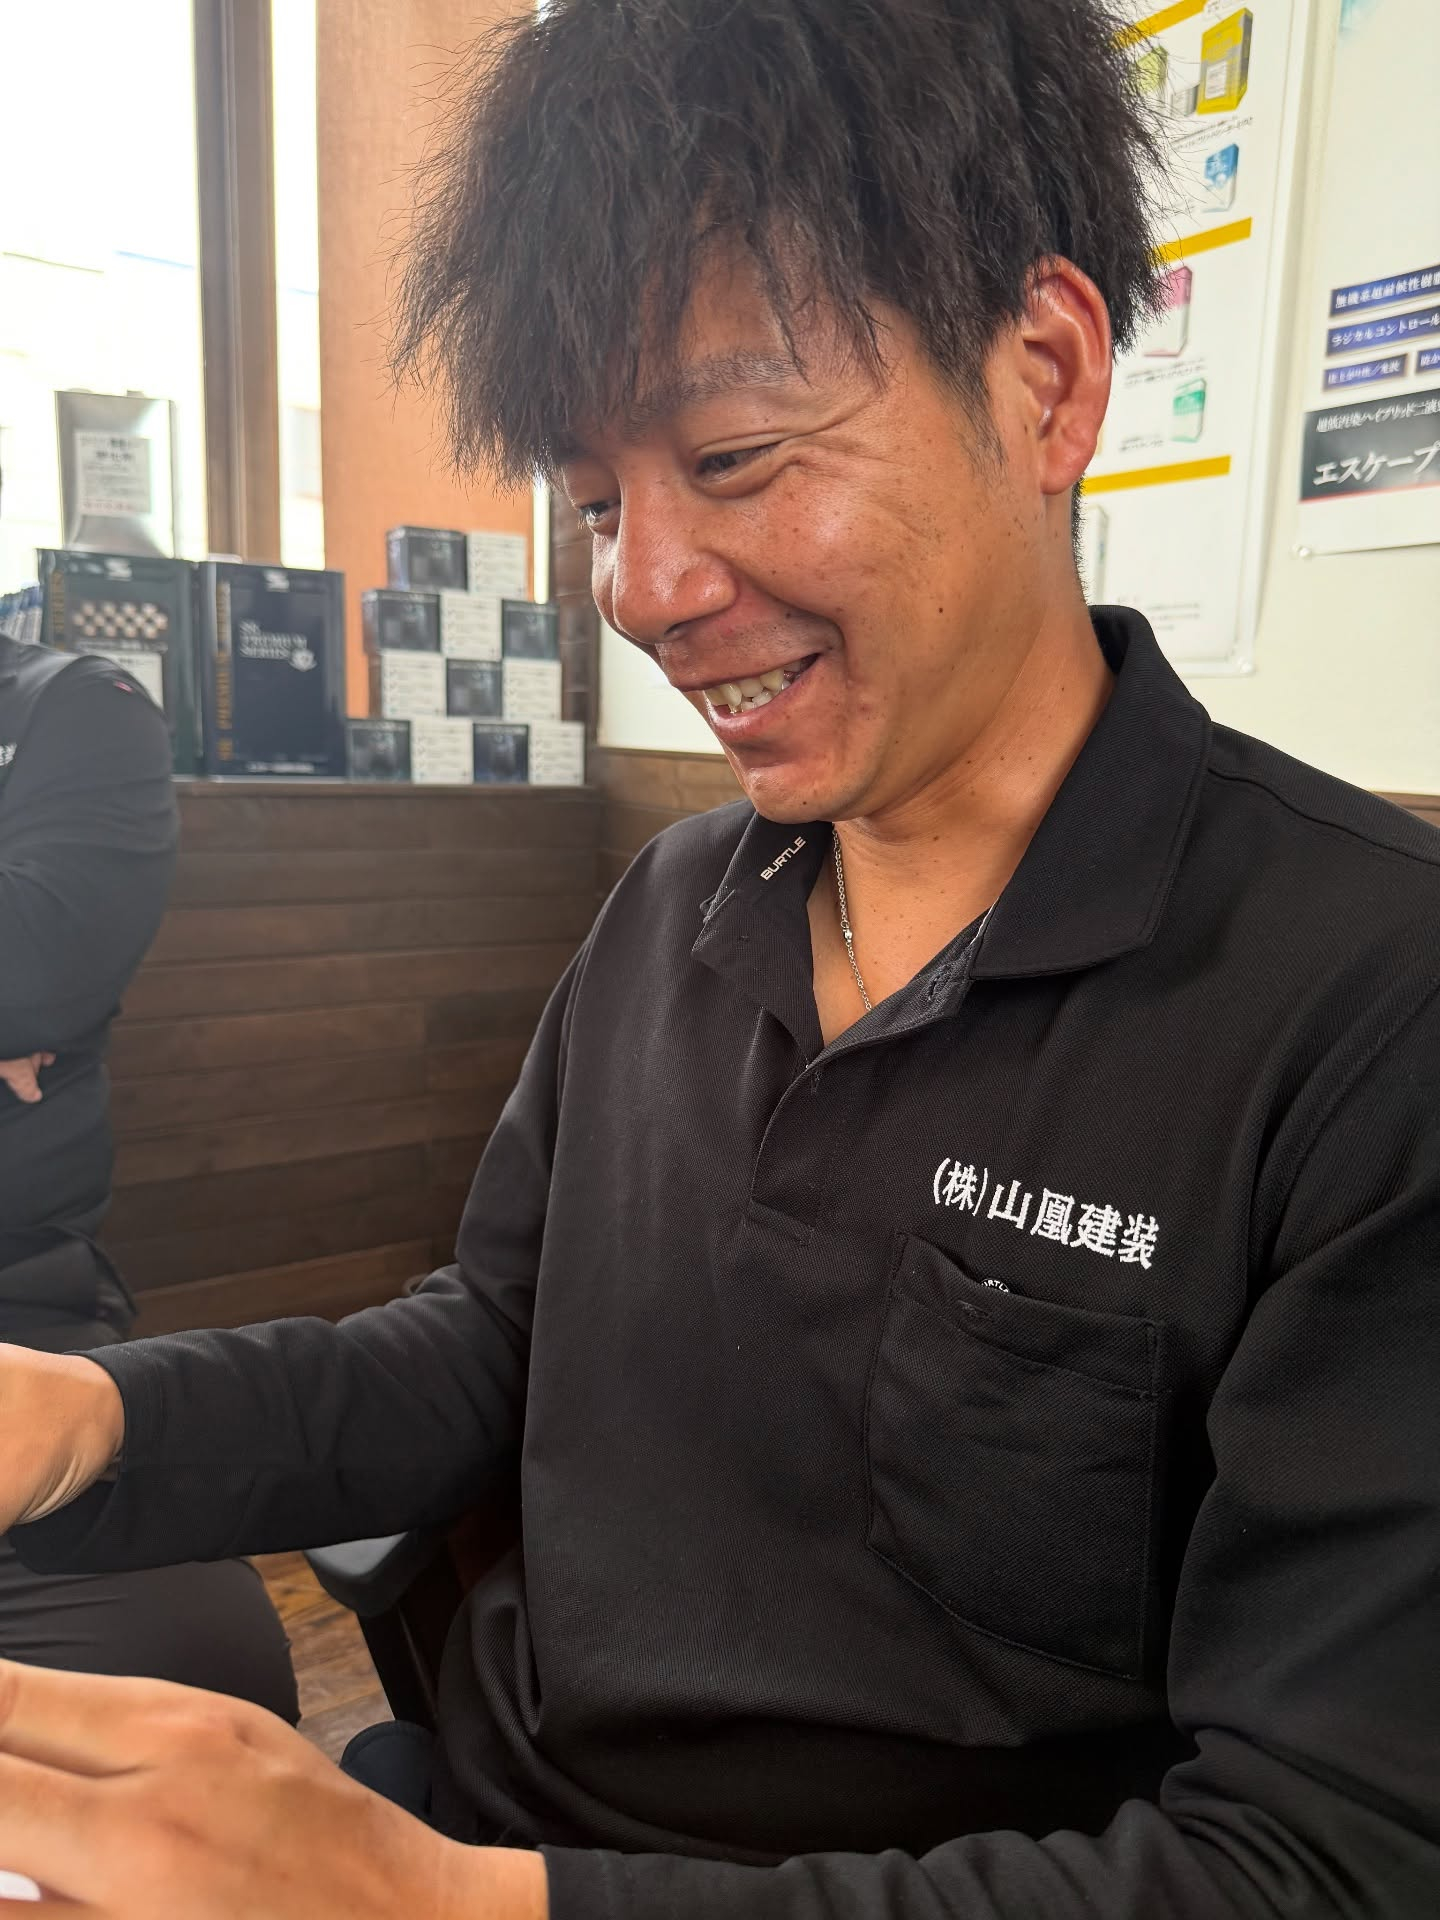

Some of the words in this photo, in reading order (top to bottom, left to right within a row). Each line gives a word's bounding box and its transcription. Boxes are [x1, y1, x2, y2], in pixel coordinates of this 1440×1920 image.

[1312, 439, 1440, 486] エスケープ
[760, 836, 807, 881] BURTLE
